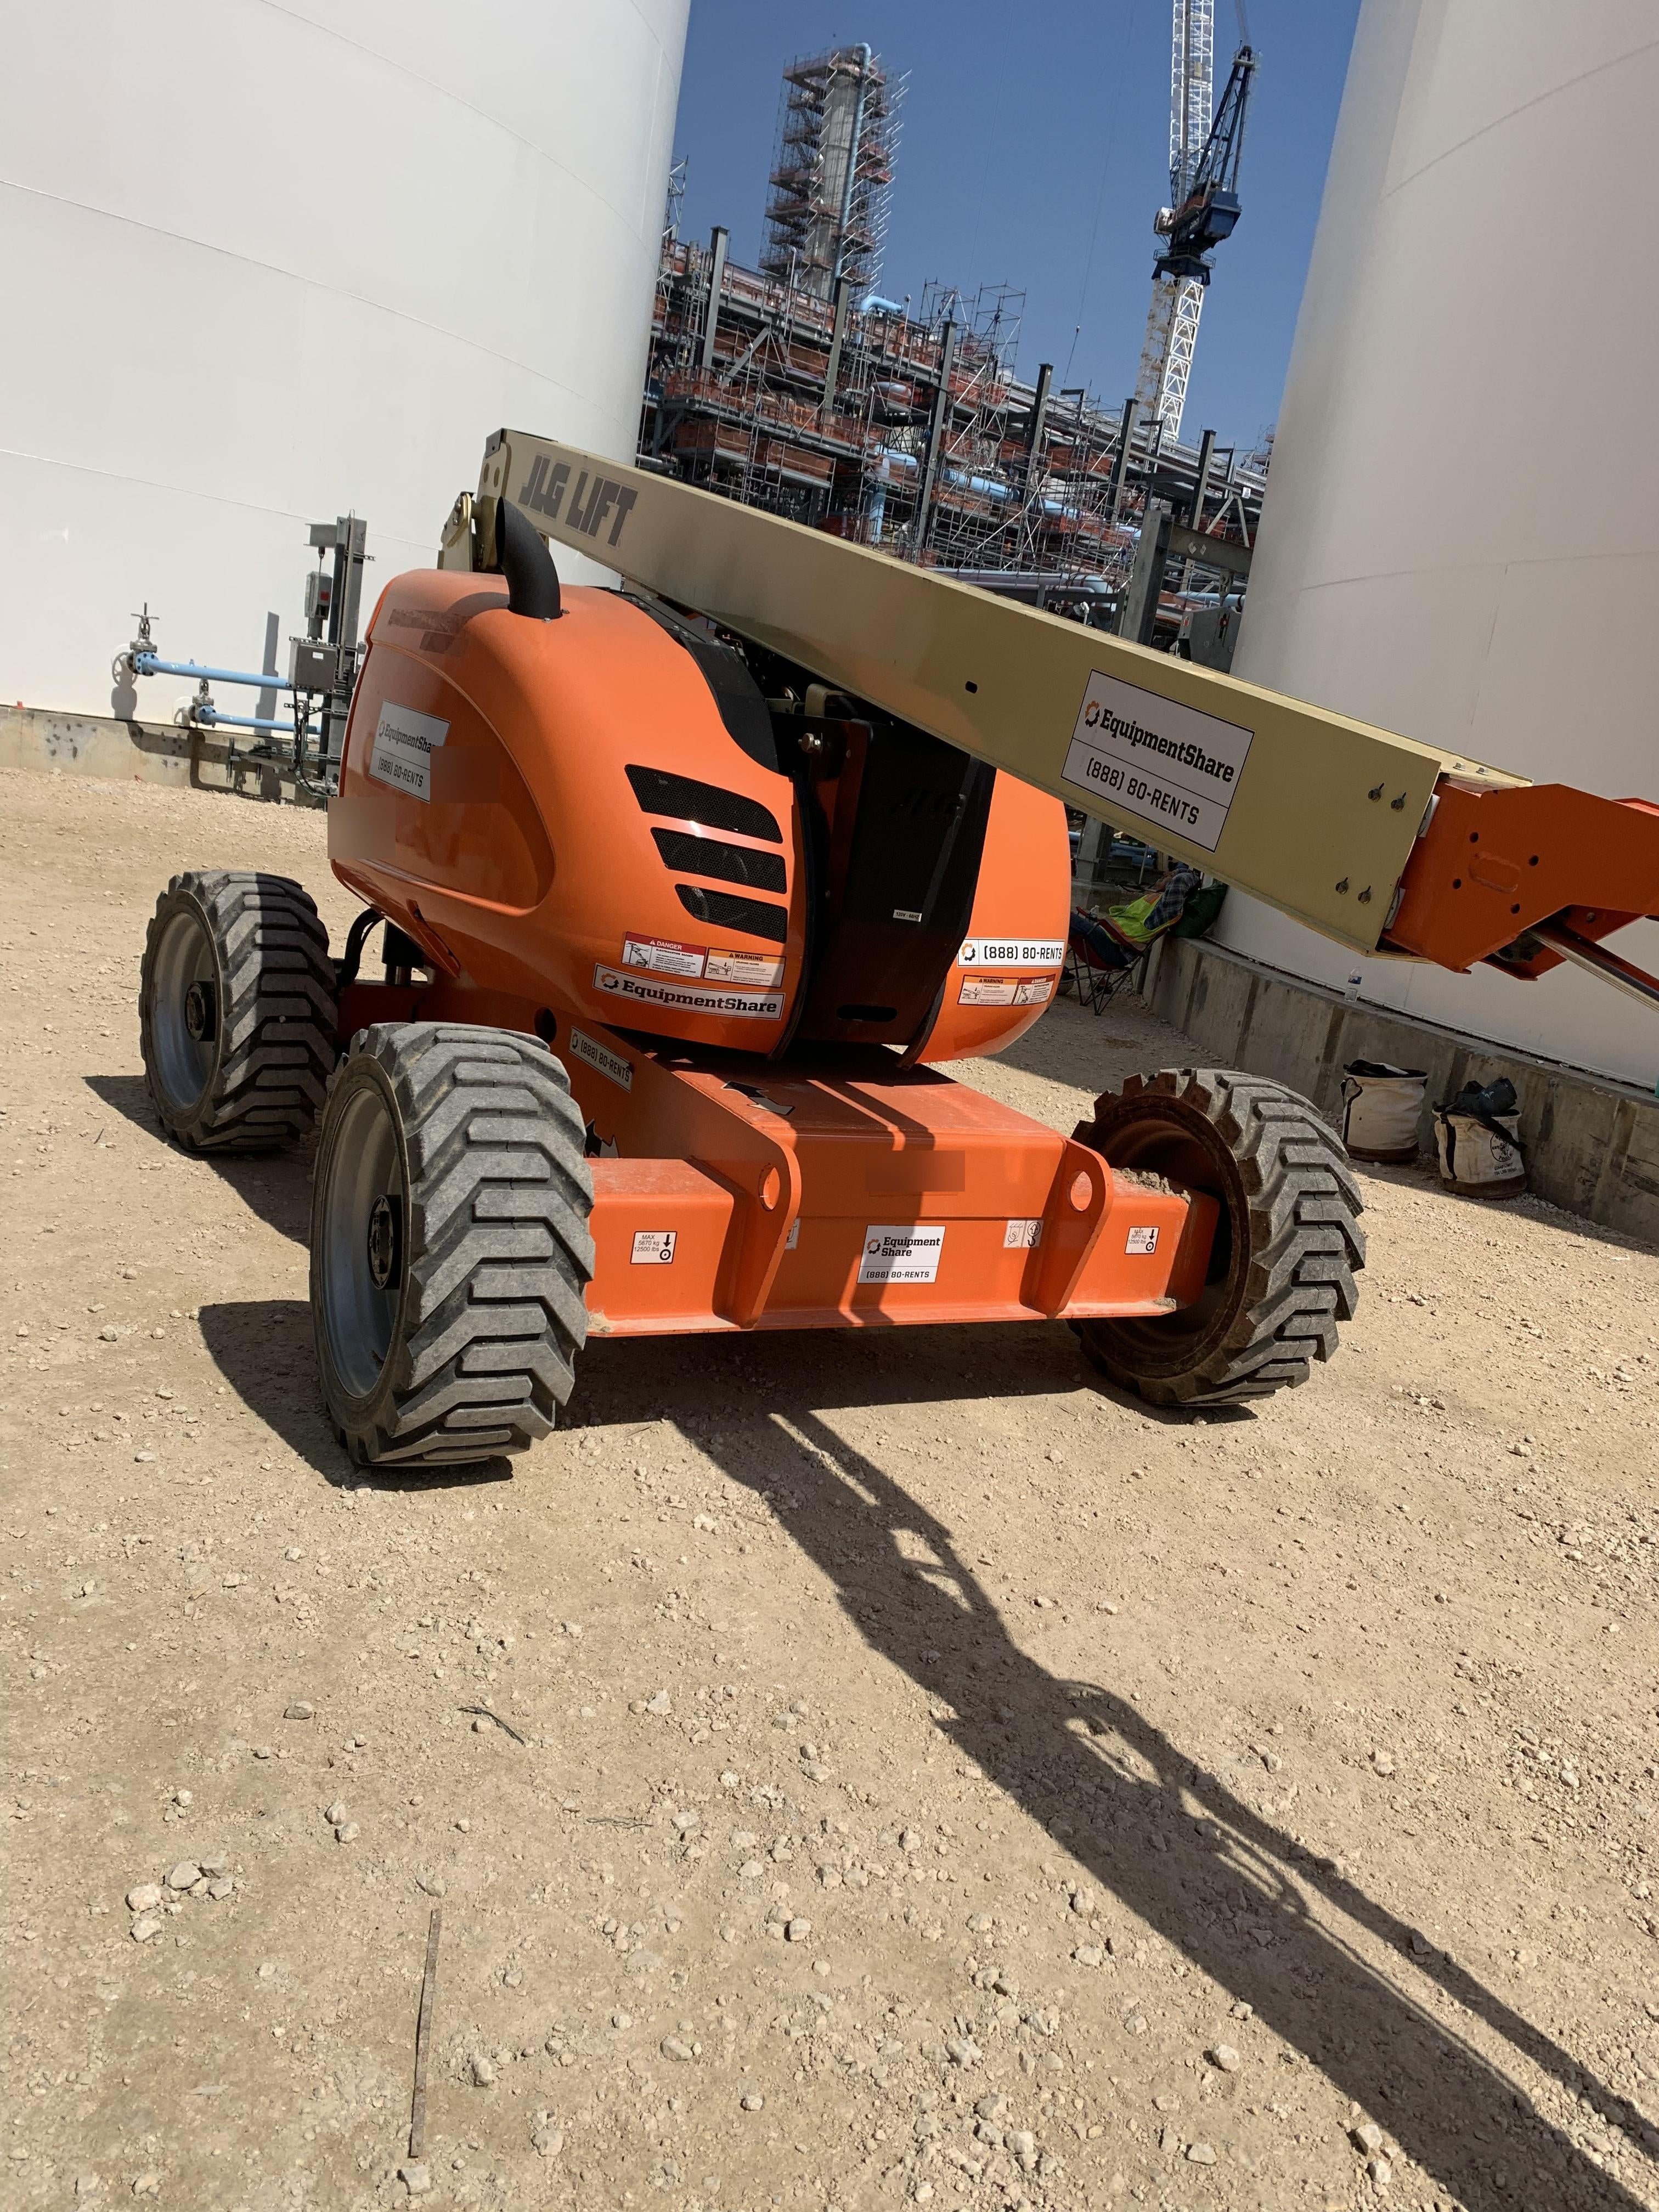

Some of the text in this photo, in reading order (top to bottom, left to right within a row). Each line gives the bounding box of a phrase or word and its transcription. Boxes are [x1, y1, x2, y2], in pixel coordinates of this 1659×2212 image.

[518, 454, 639, 547] JLG LIFT
[385, 724, 441, 753] EquipmentSha
[1100, 708, 1234, 783] EquipmentShare
[378, 757, 424, 787] (888) 80-RENTS
[1086, 757, 1199, 825] (888) 80-RENTS
[657, 940, 682, 950] DANGER
[984, 946, 1062, 960] (888) 80-RENTS
[622, 980, 777, 1013] EquipmentShare
[580, 1040, 630, 1082] (888) 80-RENTS
[881, 1248, 912, 1257] Share
[883, 1237, 940, 1249] Equipment
